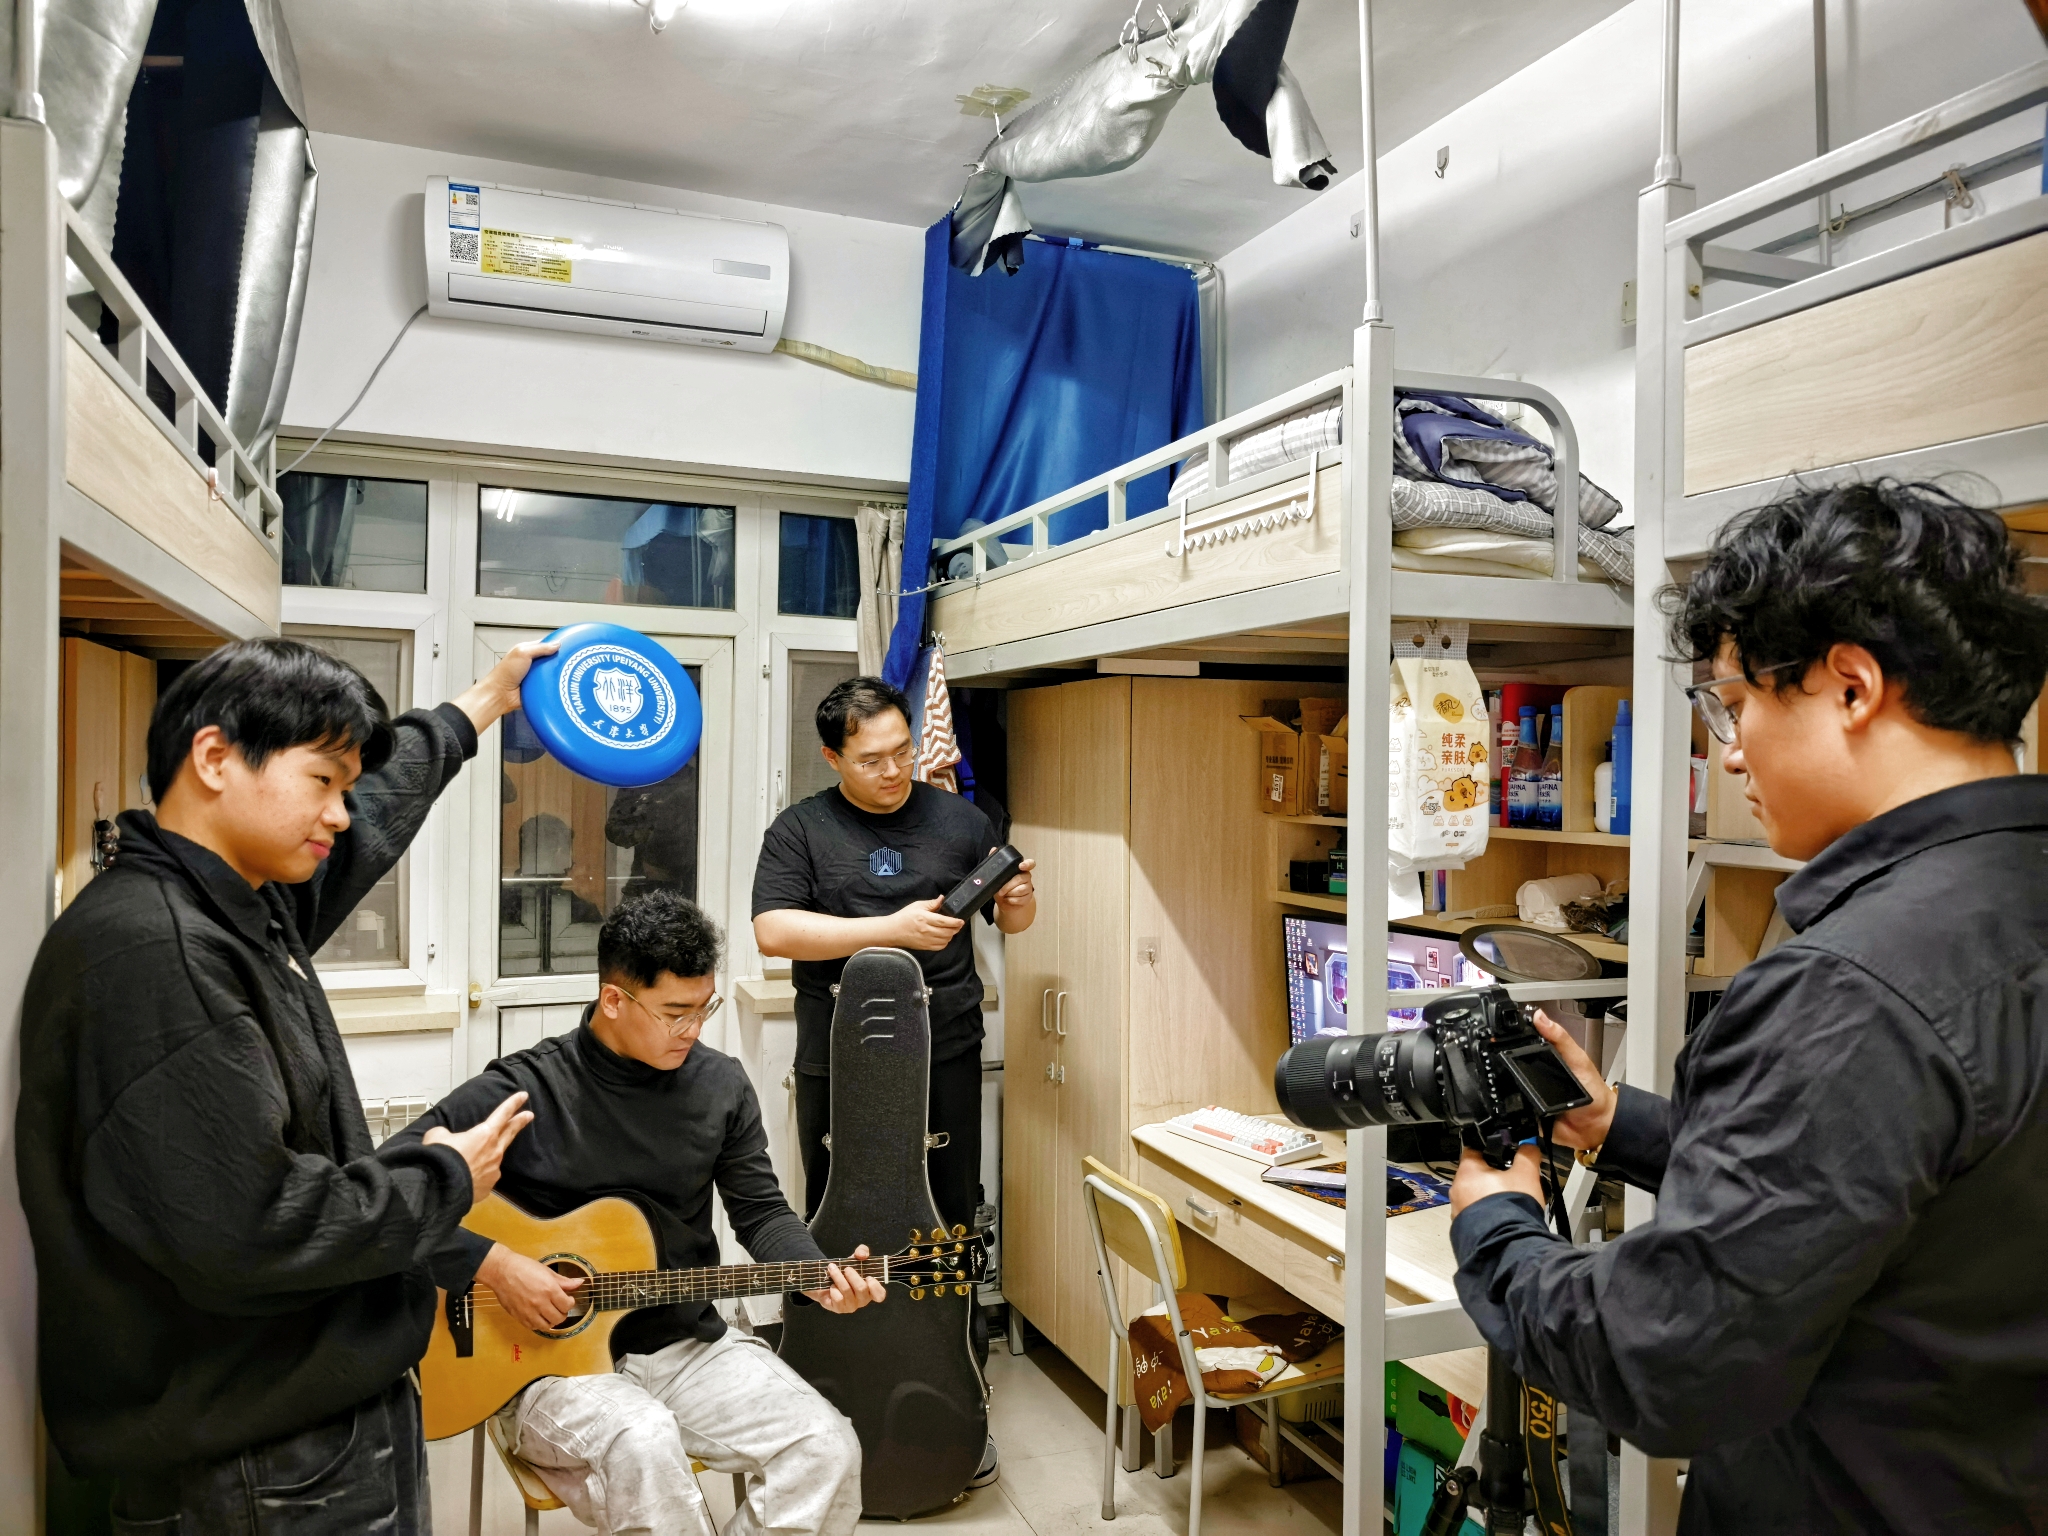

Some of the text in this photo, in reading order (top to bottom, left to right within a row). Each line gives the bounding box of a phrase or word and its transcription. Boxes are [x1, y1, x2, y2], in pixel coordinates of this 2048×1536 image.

[570, 654, 666, 724] TIANJIN UNIVERSITY (PEIYANG UNIVERSITY)
[609, 704, 632, 714] 1895
[1442, 732, 1466, 748] 纯柔
[1441, 750, 1466, 765] 亲肤
